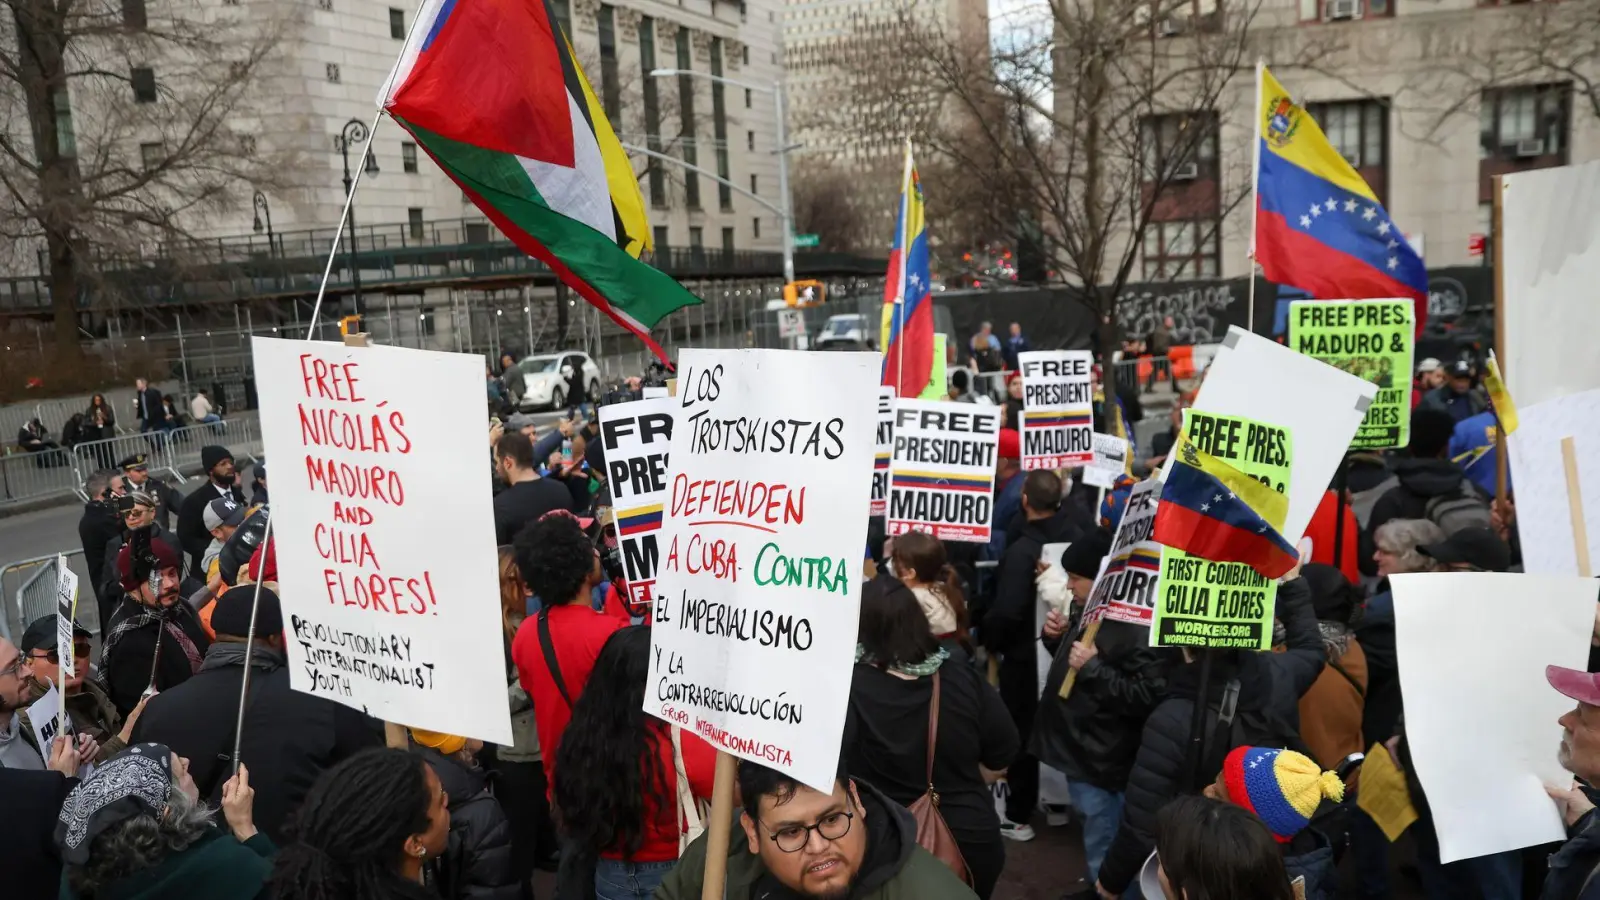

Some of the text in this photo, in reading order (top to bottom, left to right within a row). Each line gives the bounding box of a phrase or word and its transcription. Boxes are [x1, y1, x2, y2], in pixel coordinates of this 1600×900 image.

[1300, 306, 1347, 327] FREE
[1354, 304, 1410, 326] PRES.
[1300, 332, 1405, 354] MADURO &
[300, 354, 365, 402] FREE
[682, 364, 724, 407] LOS
[1023, 360, 1087, 377] FREE
[1026, 382, 1090, 406] PRESIDENT
[298, 401, 411, 453] NICOLÁS
[602, 413, 673, 450] FR
[688, 409, 844, 459] TROTSKISTAS
[896, 408, 995, 434] FREE
[1189, 414, 1290, 467] FREE PRES.
[894, 436, 995, 466] PRESIDENT
[306, 455, 404, 506] MADURO
[671, 473, 806, 525] DEFIENDEN
[334, 501, 373, 526] AND
[890, 489, 989, 524] MADURO
[315, 523, 380, 570] CILIA
[667, 534, 678, 572] A
[754, 543, 848, 595] CONTRA
[1167, 558, 1202, 582] FIRST
[324, 569, 437, 615] FLORES!
[1166, 584, 1265, 619] CILIA FLORES
[291, 614, 411, 662] REVOLUTIONARY
[656, 589, 813, 651] EL IMPERIALISMO
[1164, 634, 1206, 645] WORKERS
[1234, 638, 1258, 647] PARTY
[299, 641, 434, 690] INTERNATIONALIST
[305, 666, 352, 696] YOUTH
[654, 644, 684, 675] Y LA
[658, 676, 802, 724] CONTRARREVOLUCIÓN
[661, 702, 792, 767] GRUPO INTERNACIONALISTA
